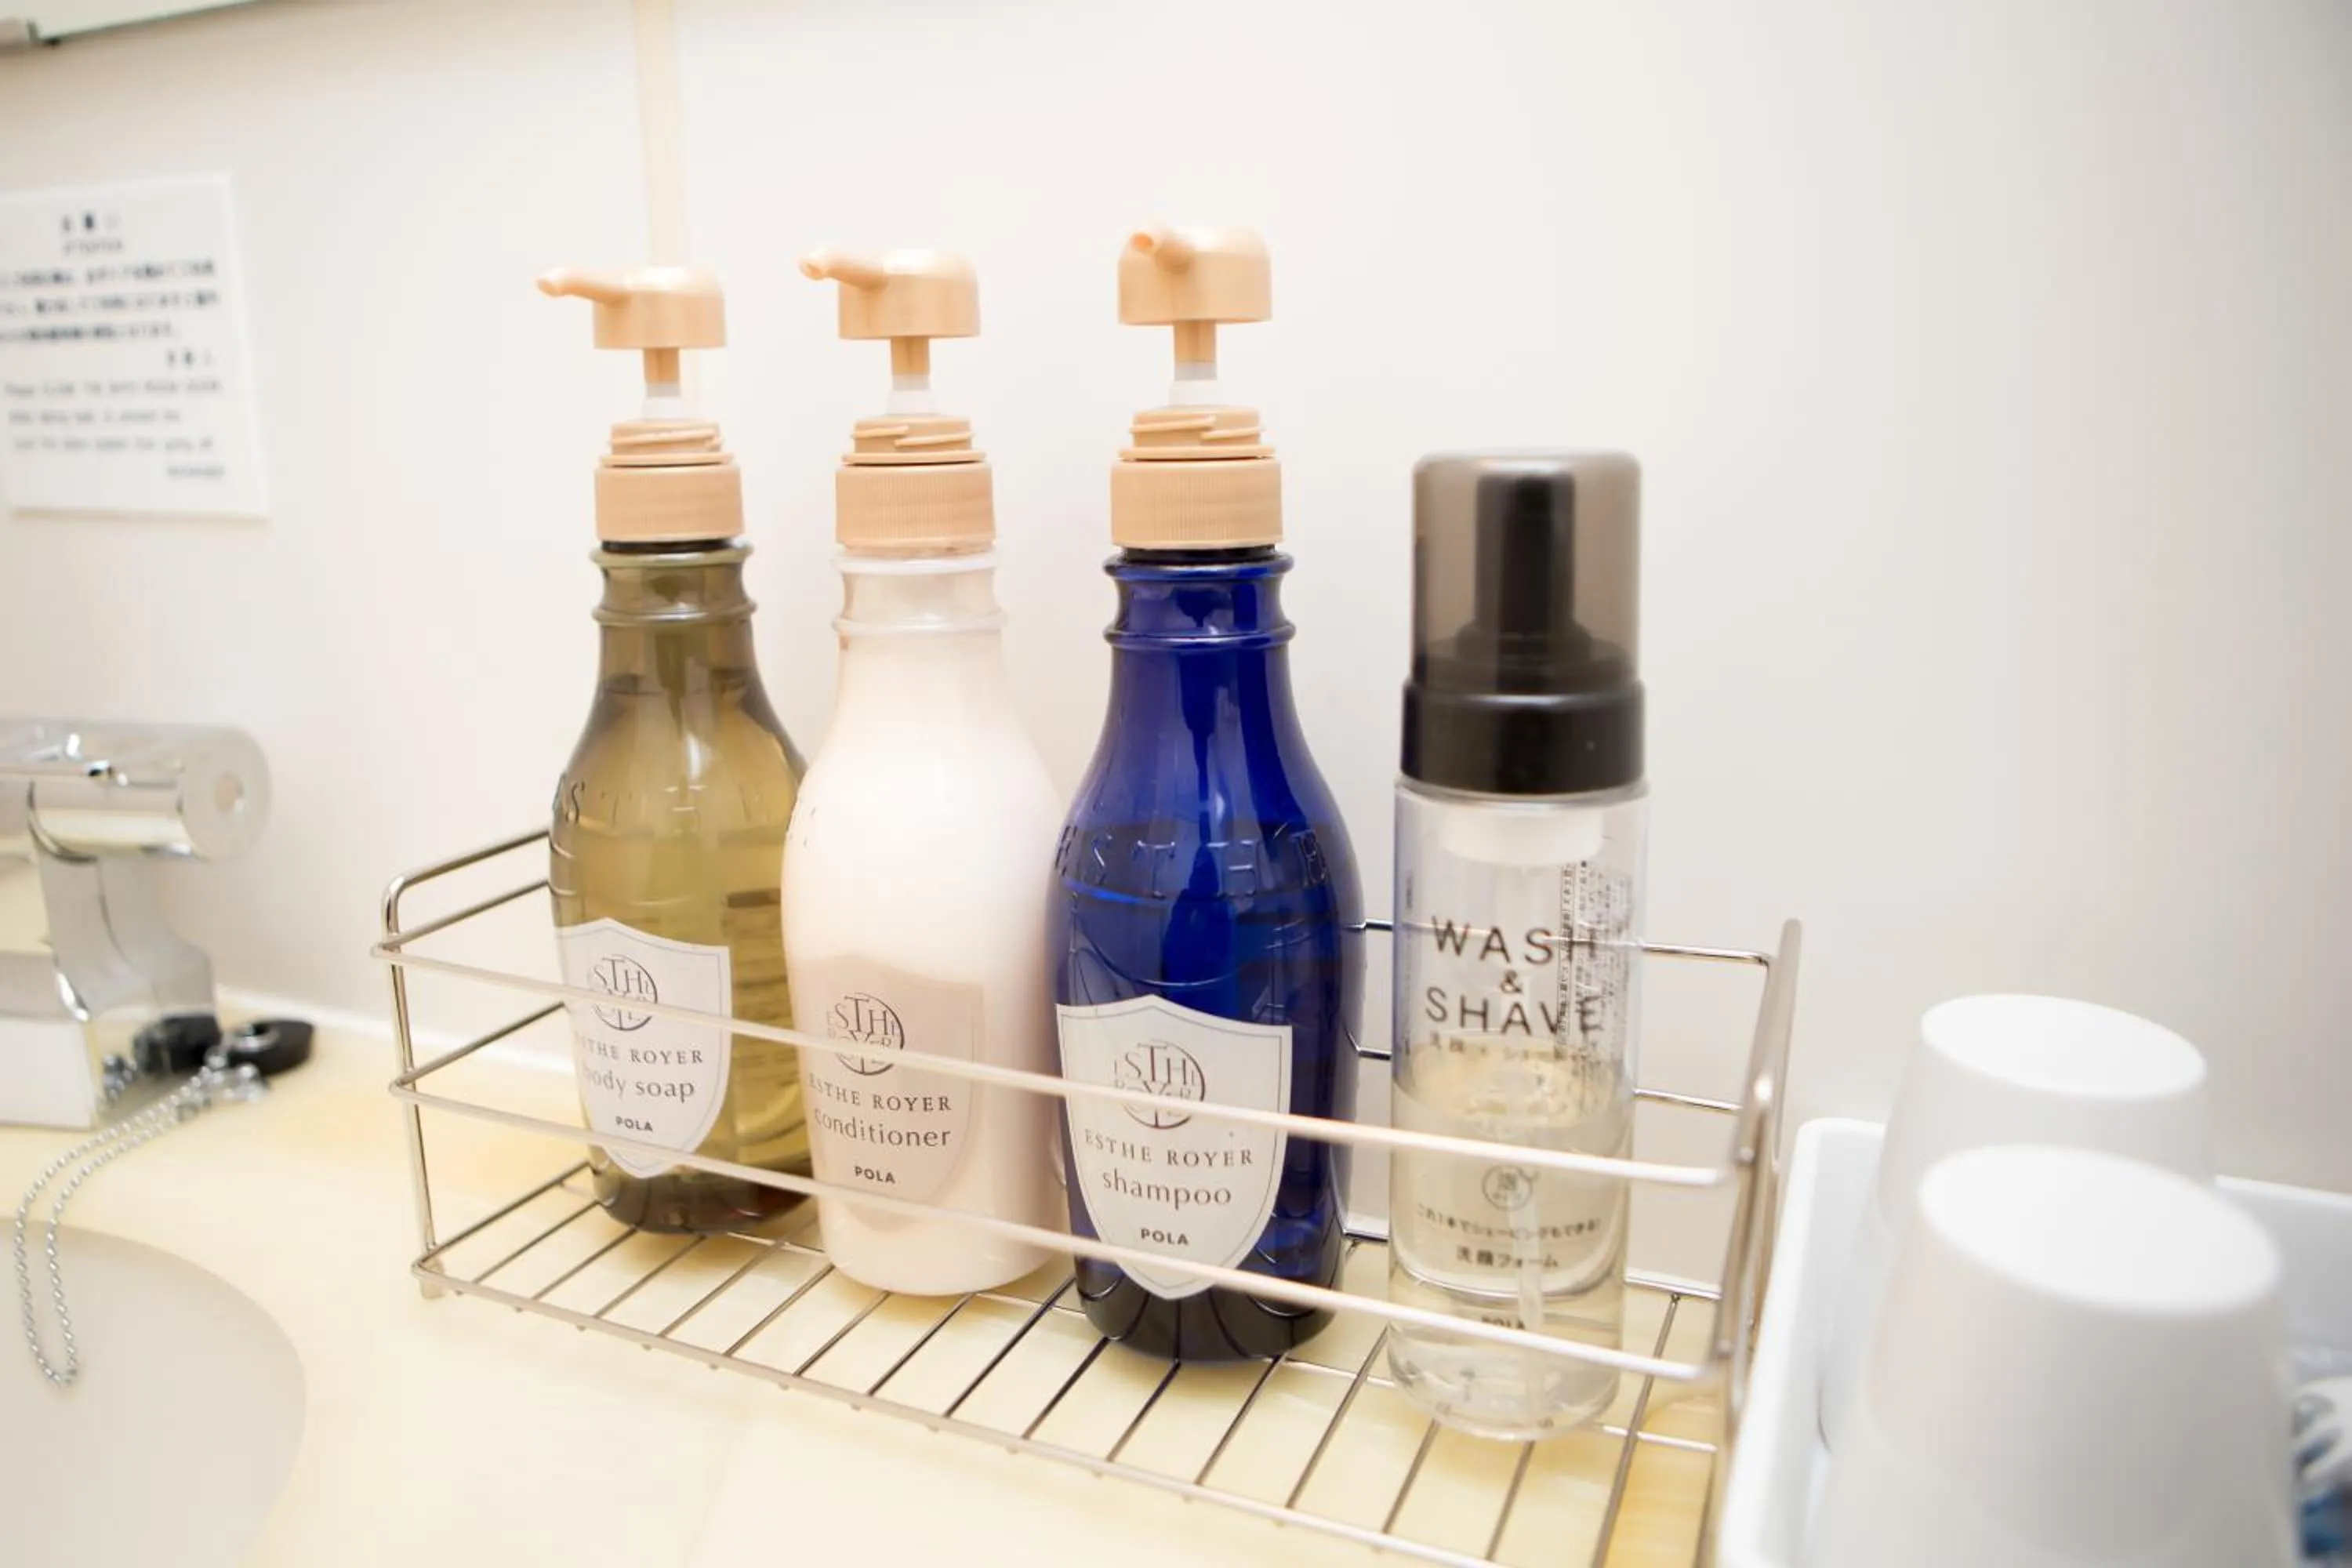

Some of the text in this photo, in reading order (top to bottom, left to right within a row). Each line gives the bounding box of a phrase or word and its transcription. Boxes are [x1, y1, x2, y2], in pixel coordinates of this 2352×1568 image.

[1432, 916, 1596, 965] WASH
[1500, 970, 1523, 995] &
[1425, 985, 1604, 1036] SHAVE
[630, 1048, 703, 1065] ROYER
[635, 1080, 695, 1104] soap
[808, 1073, 952, 1112] ESTHE ROYER
[615, 1115, 653, 1133] POLA
[815, 1108, 952, 1148] conditioner
[1083, 1129, 1254, 1168] ESTHE ROYER
[854, 1165, 896, 1185] POLA
[1102, 1168, 1232, 1210] shampoo
[1141, 1227, 1189, 1246] POLA
